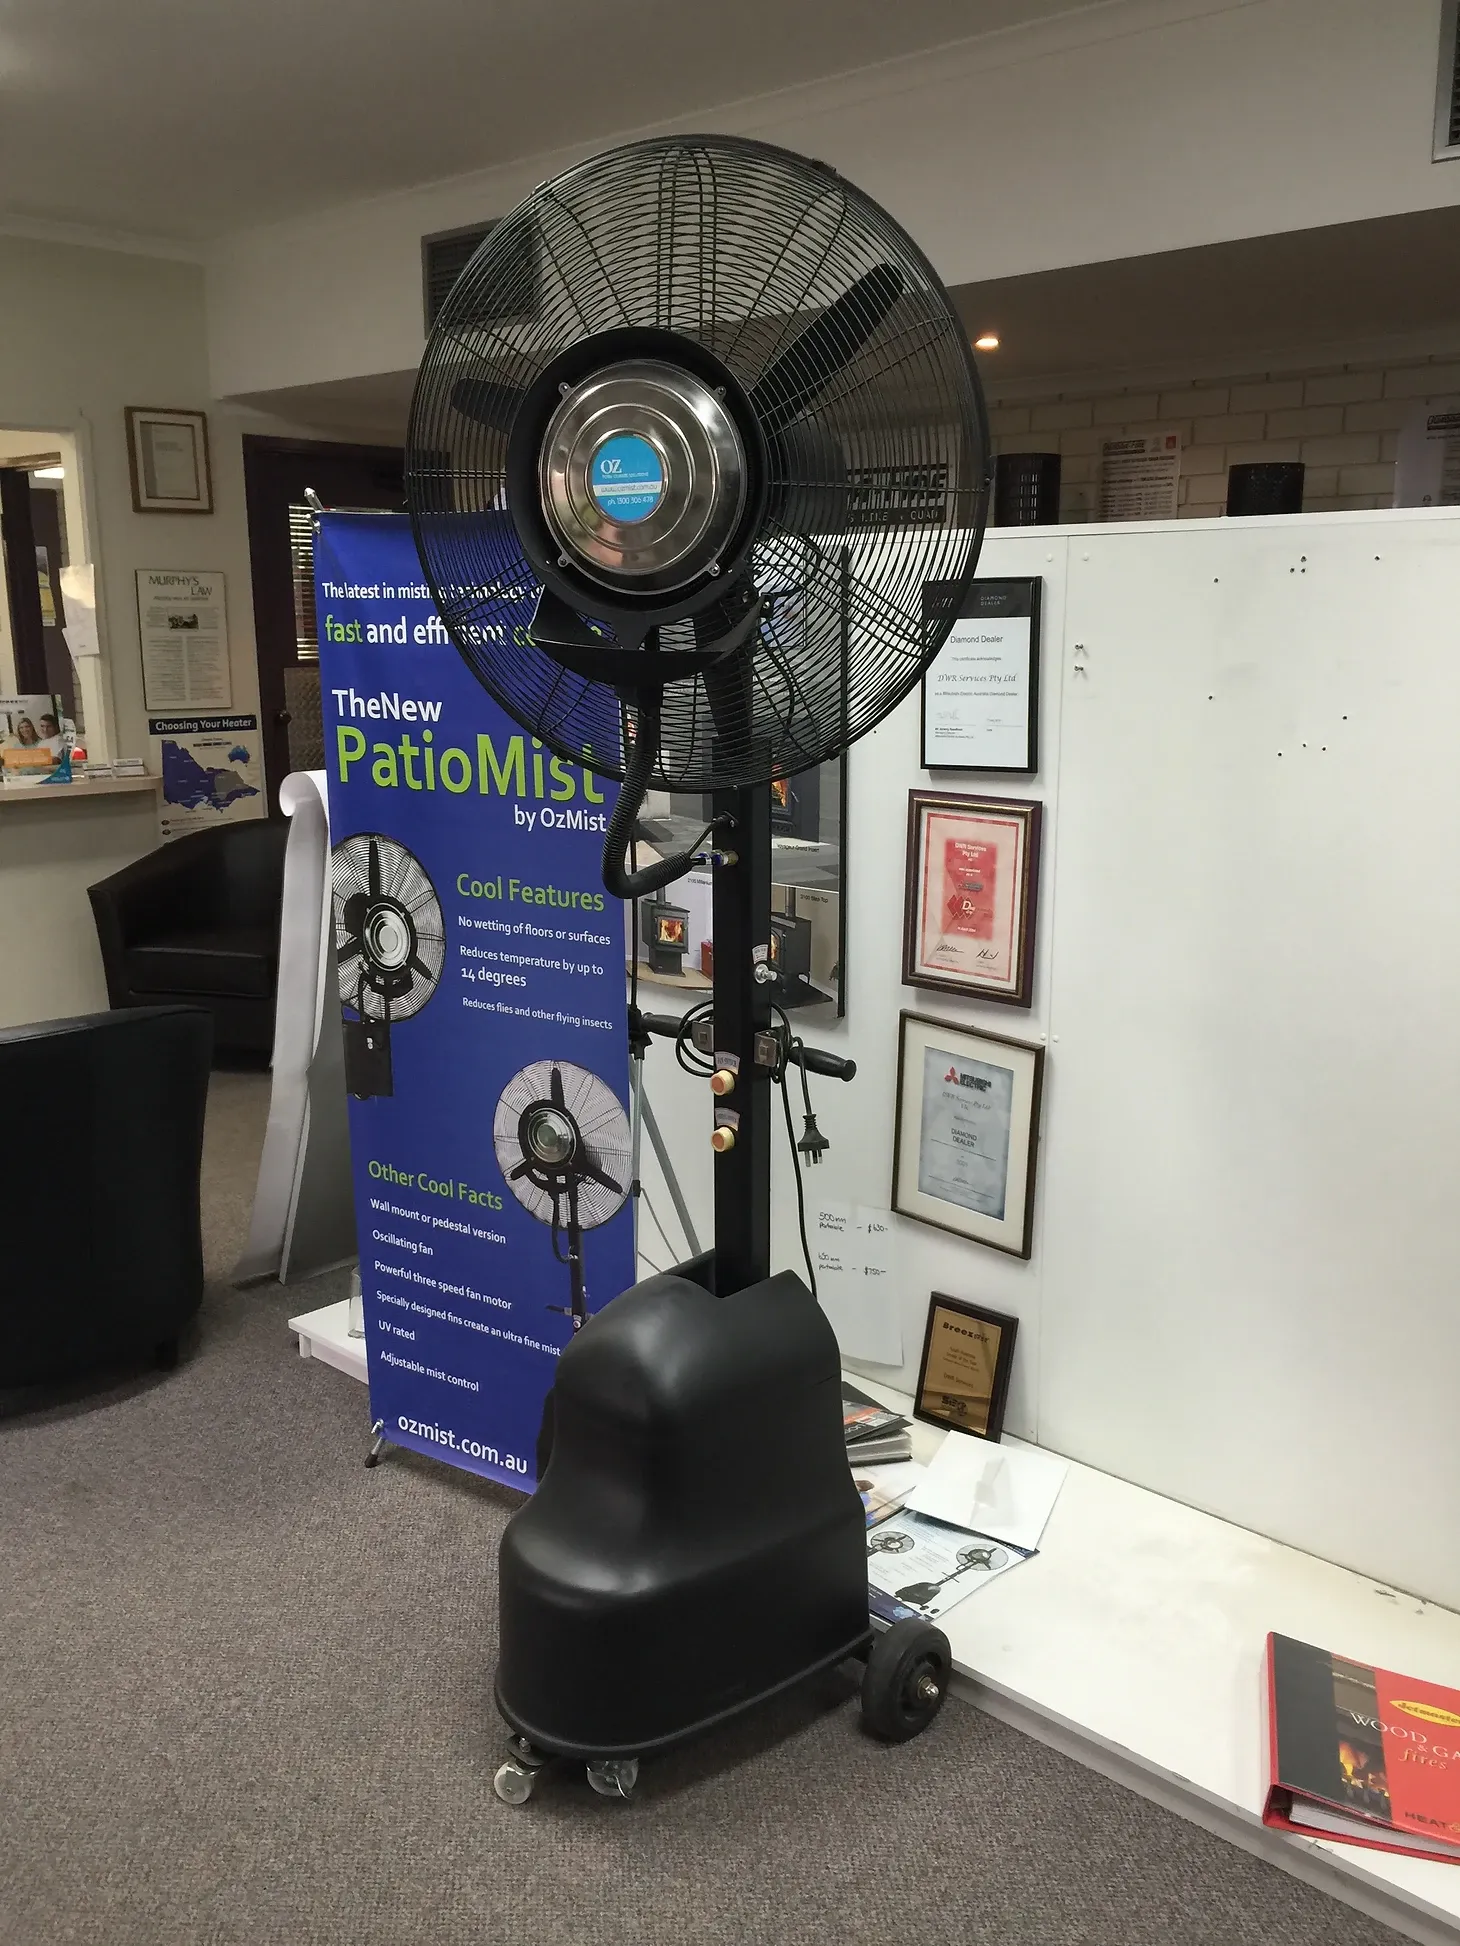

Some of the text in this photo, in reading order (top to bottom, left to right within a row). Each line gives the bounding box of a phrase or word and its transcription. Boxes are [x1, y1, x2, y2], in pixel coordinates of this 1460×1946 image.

[600, 459, 622, 475] OZ
[148, 575, 200, 586] MURPHY'S
[190, 587, 213, 596] LAW
[382, 582, 396, 600] in
[398, 582, 446, 604] mistig
[325, 614, 363, 643] fast
[366, 616, 407, 644] and
[413, 616, 507, 646] effiient
[950, 635, 1004, 644] Diamond Dealer
[958, 674, 987, 682] Services
[988, 674, 1002, 684] Pty
[1003, 673, 1018, 682] Ltd
[155, 719, 252, 732] Choosing Your Heater
[336, 725, 605, 804] PatioMist
[514, 804, 607, 833] by OzMist
[456, 873, 605, 912] Cool Features
[458, 916, 611, 945] No wetting of floors or surfaces
[460, 945, 604, 976] Reduces temperature by up to
[461, 967, 527, 987] 14 degrees
[462, 997, 613, 1030] Reduces flies and other flying insects
[951, 1127, 978, 1142] DIAMOND
[952, 1135, 975, 1148] DEALER
[368, 1160, 503, 1210] Other Cool Facts
[370, 1198, 506, 1244] Wall mount or pedestal version
[372, 1229, 434, 1256] Oscillating fan
[374, 1260, 512, 1310] Powerful three speed fan motor
[376, 1290, 561, 1357] Specially designed fins create an ultra fine mist
[378, 1320, 415, 1341] UV rated
[381, 1350, 479, 1392] Adjustable mist control
[398, 1415, 529, 1473] ozmist.com.au
[1350, 1711, 1428, 1744] WOOD
[1399, 1748, 1448, 1770] fires
